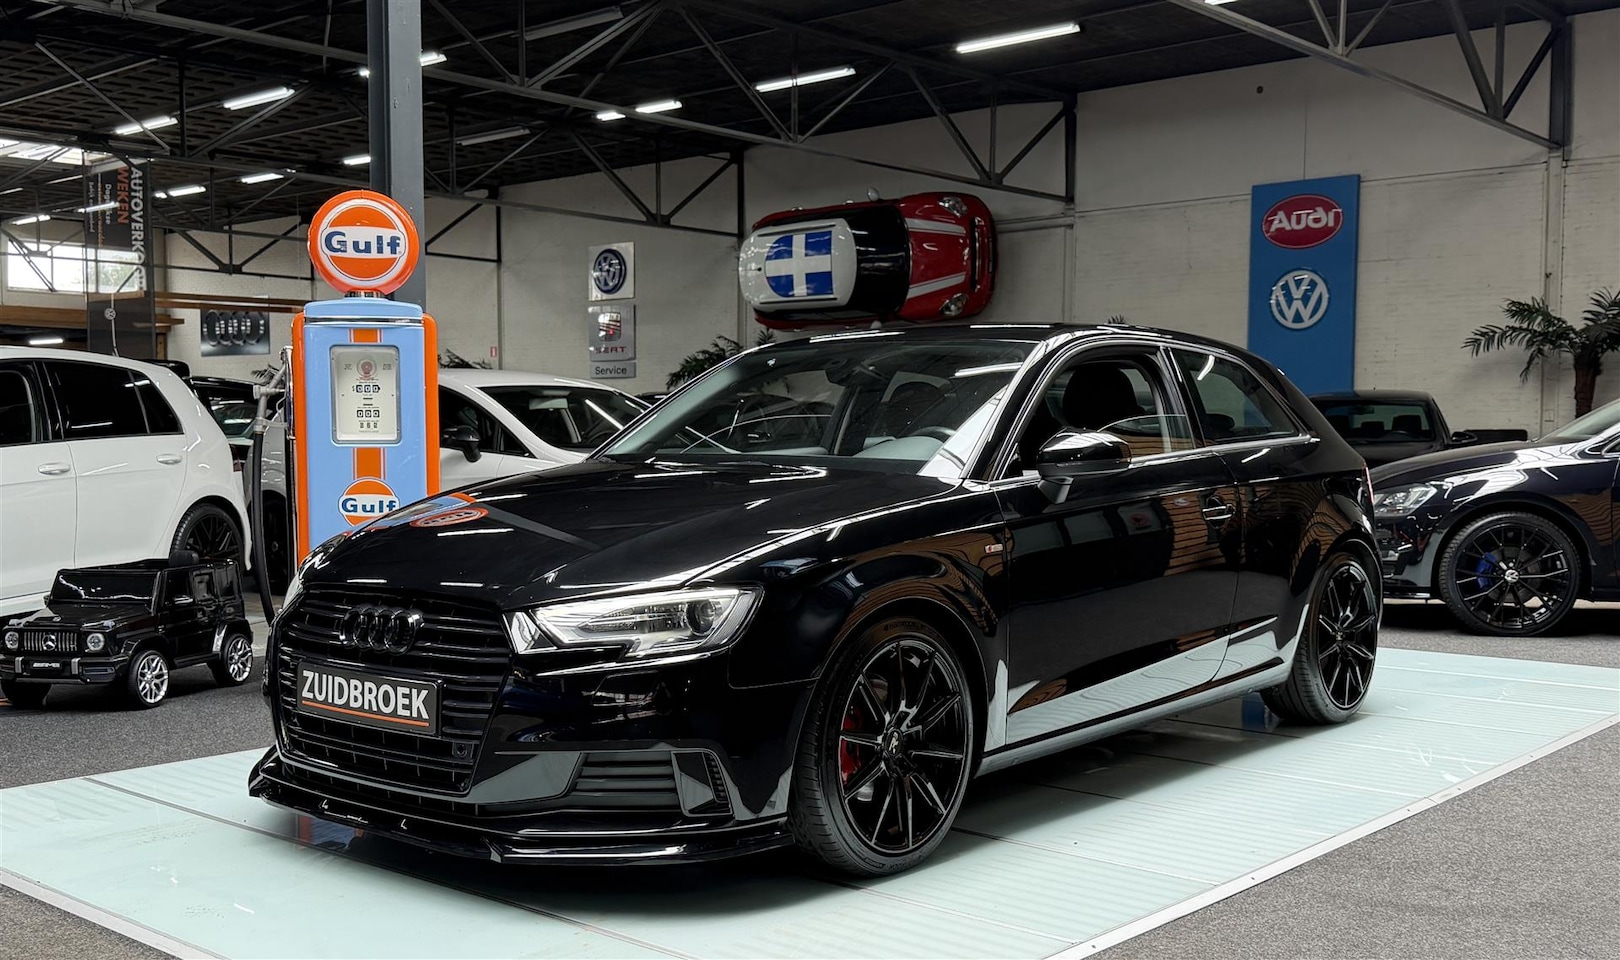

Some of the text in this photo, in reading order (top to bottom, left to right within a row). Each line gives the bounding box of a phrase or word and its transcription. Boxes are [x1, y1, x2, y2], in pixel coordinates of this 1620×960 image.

[117, 167, 129, 224] WEKEN
[1269, 206, 1335, 232] Audi
[324, 230, 401, 255] Gulf
[594, 345, 627, 354] SEAT
[594, 366, 628, 376] Service
[341, 497, 397, 513] Gulf
[301, 669, 430, 719] ZUIDBROEK
